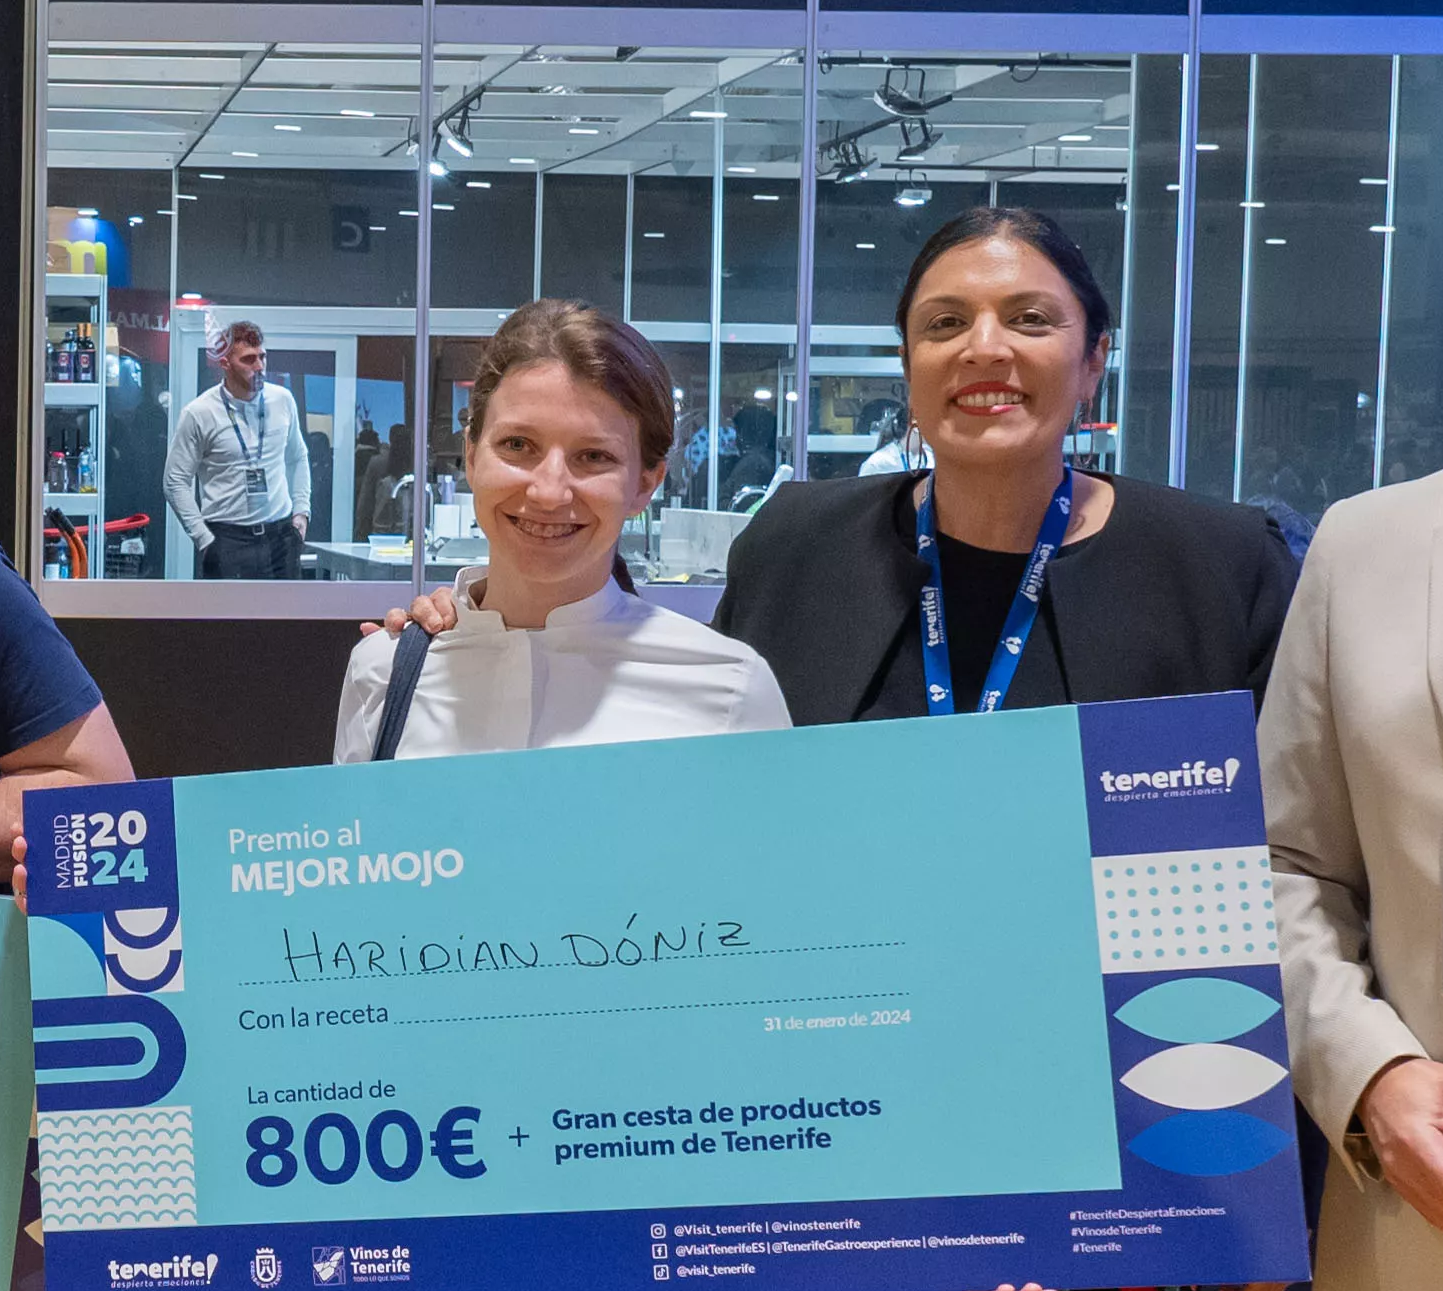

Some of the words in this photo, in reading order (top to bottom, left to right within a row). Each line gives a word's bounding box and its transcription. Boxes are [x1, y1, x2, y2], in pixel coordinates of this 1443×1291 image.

[1104, 790, 1159, 803] despierta
[1163, 787, 1224, 798] emociones
[88, 810, 148, 848] 20
[228, 823, 330, 854] Premio
[336, 819, 361, 846] al
[54, 814, 72, 888] MADRID
[68, 813, 89, 887] FUSIÓN
[90, 848, 149, 886] 24
[231, 857, 351, 897] MEJOR
[358, 848, 464, 887] MOJO
[238, 1009, 285, 1031] Con
[291, 1006, 310, 1028] la
[316, 1004, 389, 1027] receta
[763, 1016, 782, 1032] 31
[785, 1014, 805, 1031] de
[806, 1015, 846, 1030] enero
[848, 1011, 869, 1028] de
[870, 1009, 912, 1027] 2024
[247, 1086, 269, 1105] La
[274, 1080, 364, 1104] cantidad
[368, 1079, 397, 1099] de
[552, 1107, 616, 1131] Gran
[622, 1104, 693, 1128] cesta
[698, 1101, 735, 1124] de
[740, 1097, 882, 1127] productos
[245, 1106, 488, 1188] 800€
[554, 1135, 675, 1166] premium
[681, 1132, 717, 1155] de
[721, 1127, 832, 1153] Tenerife
[1069, 1206, 1226, 1221] #TenerifeDespiertaEmociones
[674, 1221, 762, 1237] @Visit_tenerife
[771, 1218, 861, 1234] @vinostenerife
[1071, 1224, 1162, 1237] #VinosdeTenerife
[349, 1246, 389, 1260] Vinos
[391, 1245, 410, 1259] de
[675, 1241, 766, 1257] @VisitTenerifeES
[772, 1236, 921, 1254] @TenerifeGastroexperience
[927, 1232, 1025, 1249] @vinosdetenerife
[1072, 1242, 1123, 1253] #Tenerife
[350, 1260, 411, 1275] Tenerife
[676, 1263, 756, 1278] @visit_tenerife
[110, 1279, 154, 1289] despierta
